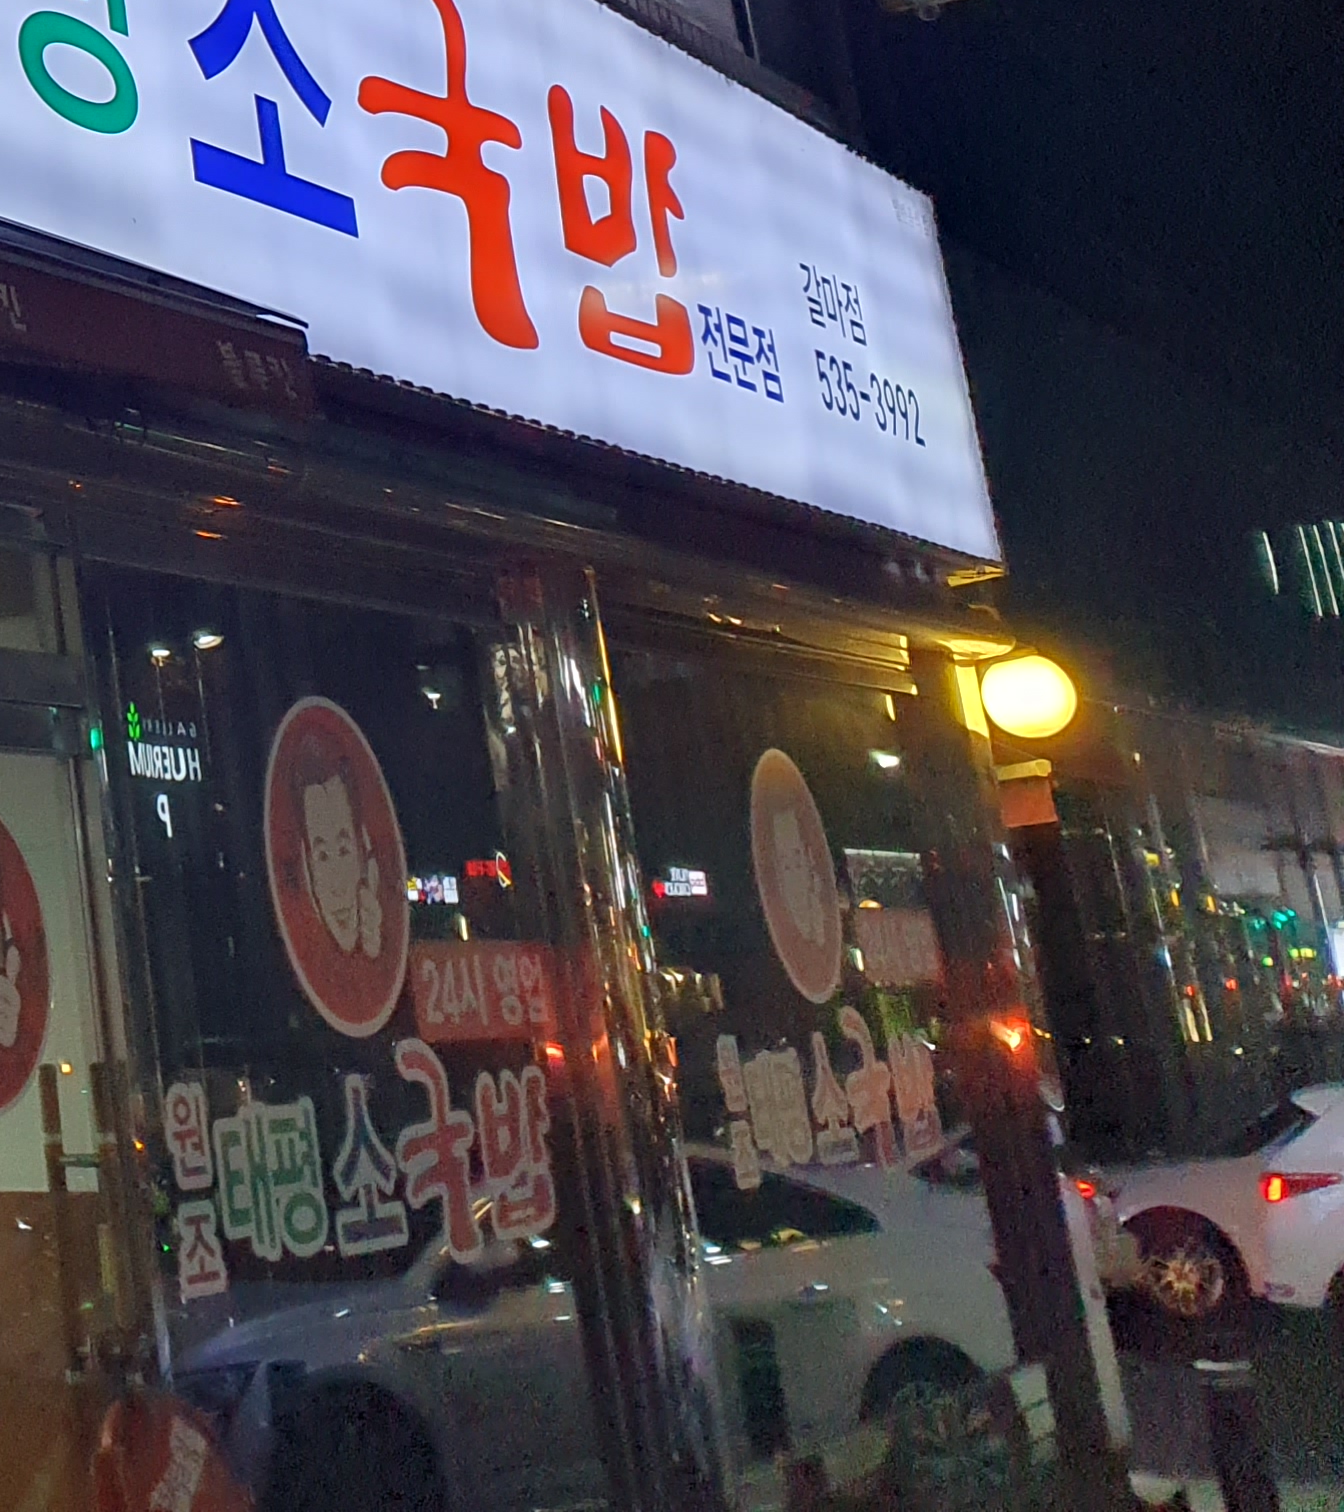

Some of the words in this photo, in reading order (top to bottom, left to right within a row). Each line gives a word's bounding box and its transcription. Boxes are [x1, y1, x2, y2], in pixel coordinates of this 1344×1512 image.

[697, 303, 784, 403] 전문점
[799, 263, 867, 346] 갈마점
[815, 349, 926, 447] 535-3992
